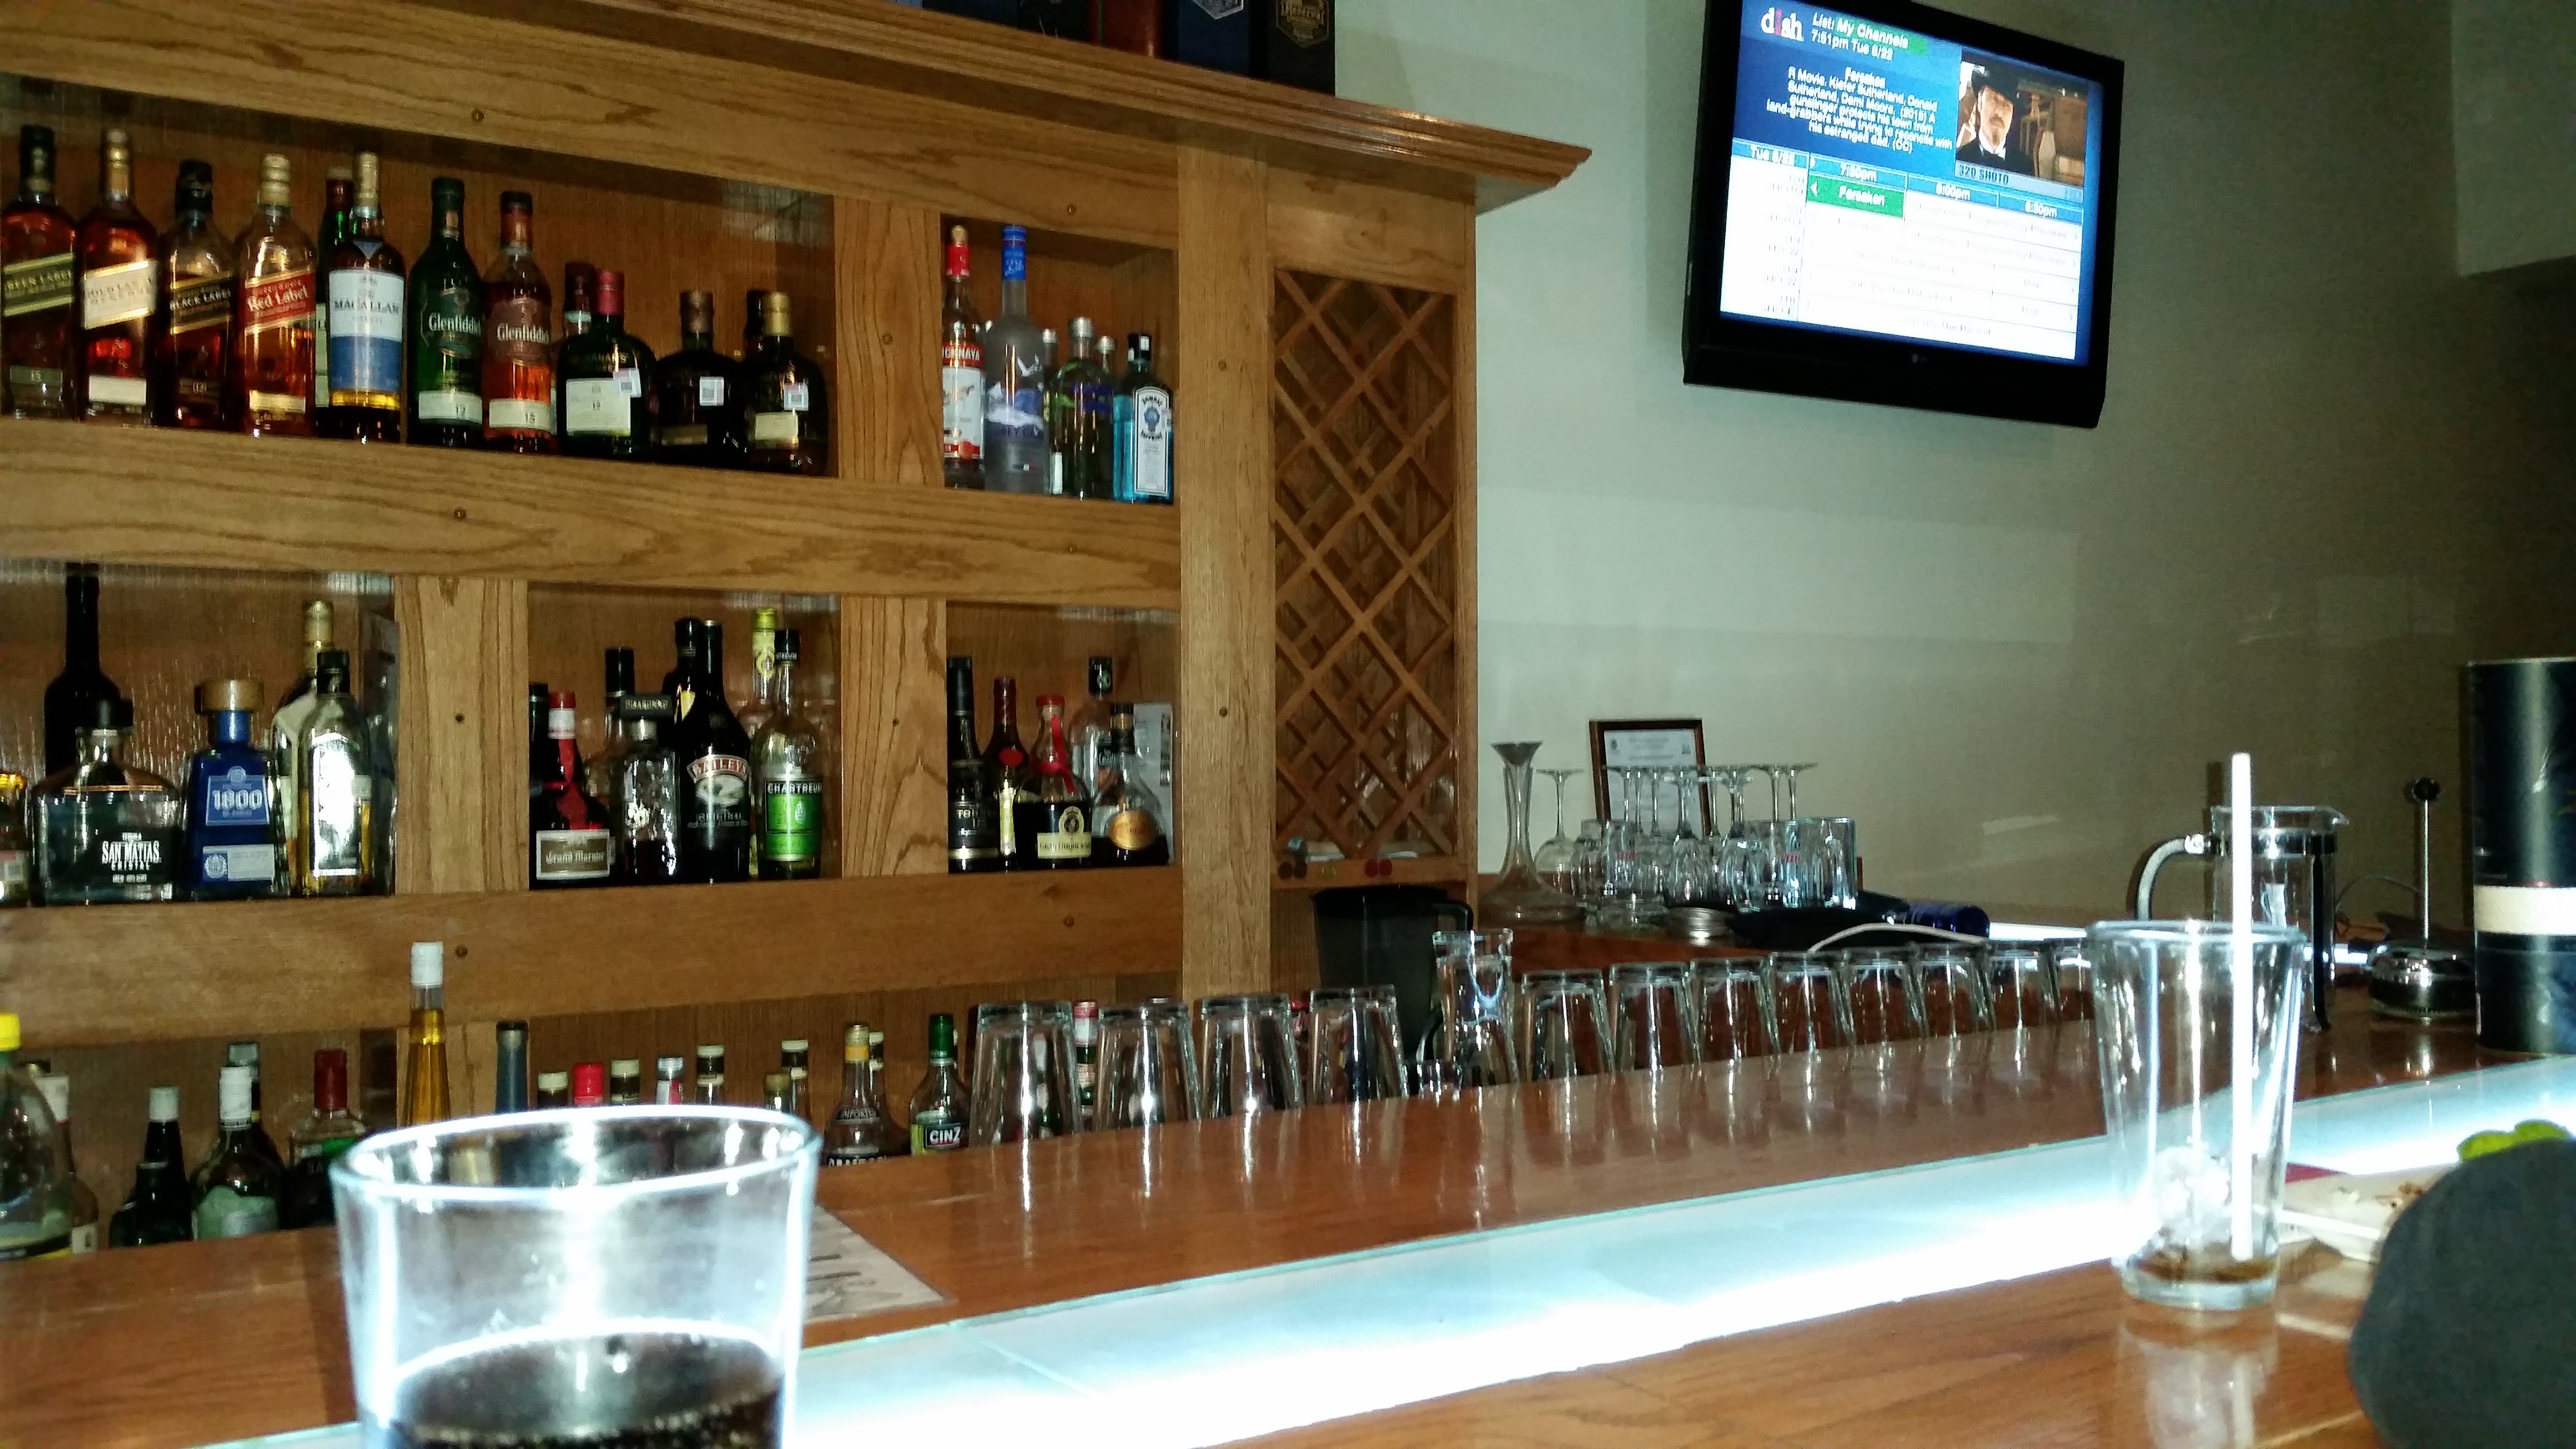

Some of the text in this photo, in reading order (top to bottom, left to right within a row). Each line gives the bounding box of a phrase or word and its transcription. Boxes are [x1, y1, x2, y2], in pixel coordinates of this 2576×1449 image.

[1761, 8, 1804, 41] dish
[1836, 17, 1855, 37] My
[1856, 24, 1909, 49] Channels
[1851, 39, 1870, 55] Tue
[1829, 75, 1856, 93] Kiefer
[1907, 94, 1938, 112] Donald
[1789, 94, 1934, 135] gunslinger protects his town from
[1841, 92, 1864, 108] Demi
[1929, 112, 1936, 125] A
[1766, 98, 1953, 150] land-grabbers while trying to reconcile with
[1809, 120, 1823, 134] his
[1824, 125, 1869, 144] estranged
[1750, 144, 1770, 161] Tue
[1959, 164, 1977, 180] 320
[1839, 185, 1885, 207] Forsaken
[246, 294, 273, 312] Red
[275, 285, 309, 305] Label
[212, 788, 262, 810] 1800
[101, 840, 160, 865] SAN MATIAS
[546, 850, 573, 865] Grand
[111, 860, 151, 871] CRISTAL
